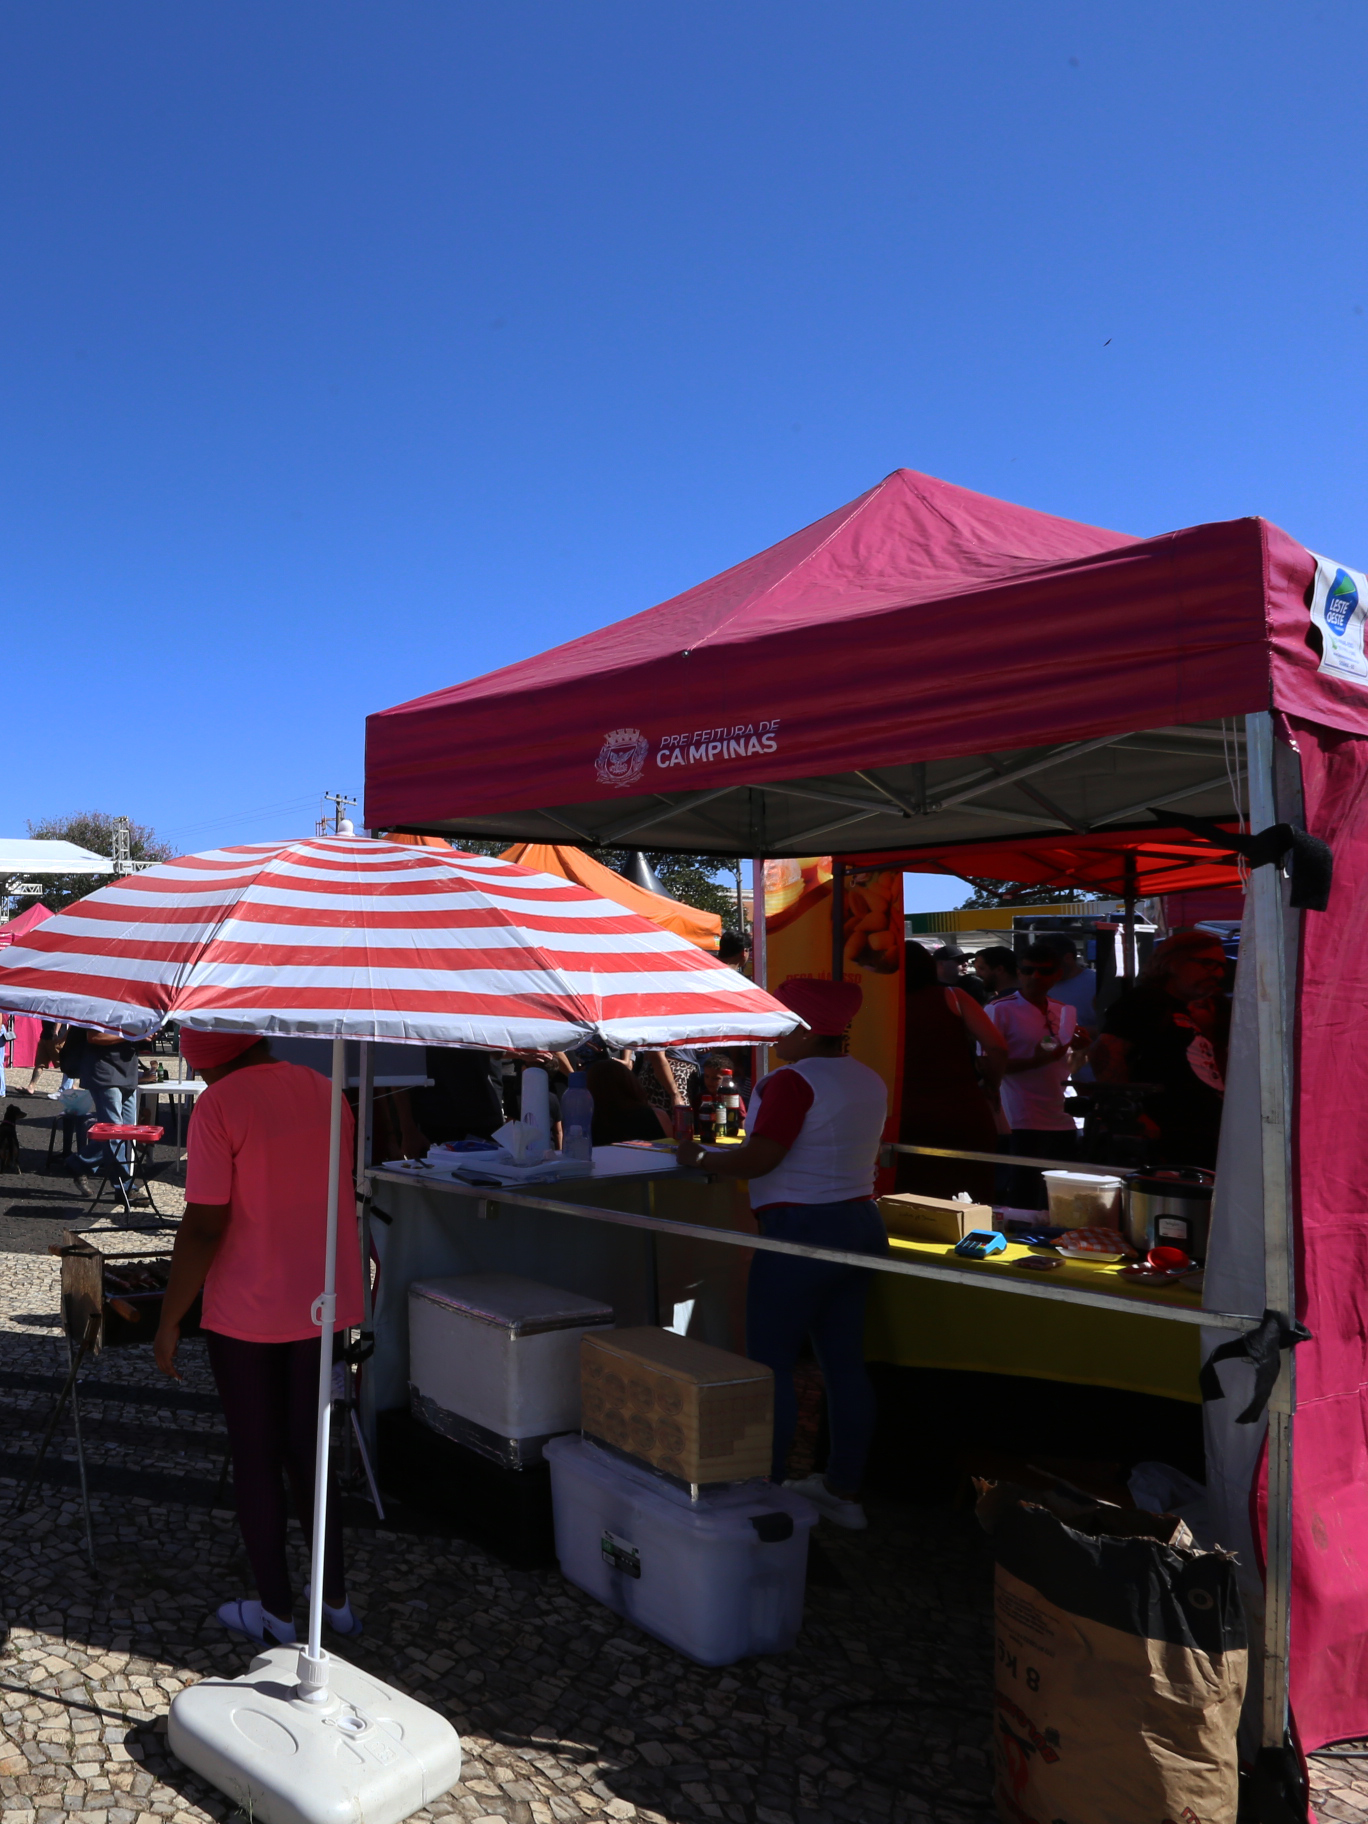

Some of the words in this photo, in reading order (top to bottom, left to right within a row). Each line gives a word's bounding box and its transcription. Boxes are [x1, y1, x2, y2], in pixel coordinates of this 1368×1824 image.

[1330, 598, 1349, 614] LESTE
[1327, 612, 1344, 626] OESTE
[660, 723, 754, 749] PREFEITURA
[758, 719, 781, 734] DE
[656, 733, 777, 768] CAMPINAS
[1026, 1667, 1040, 1692] 8
